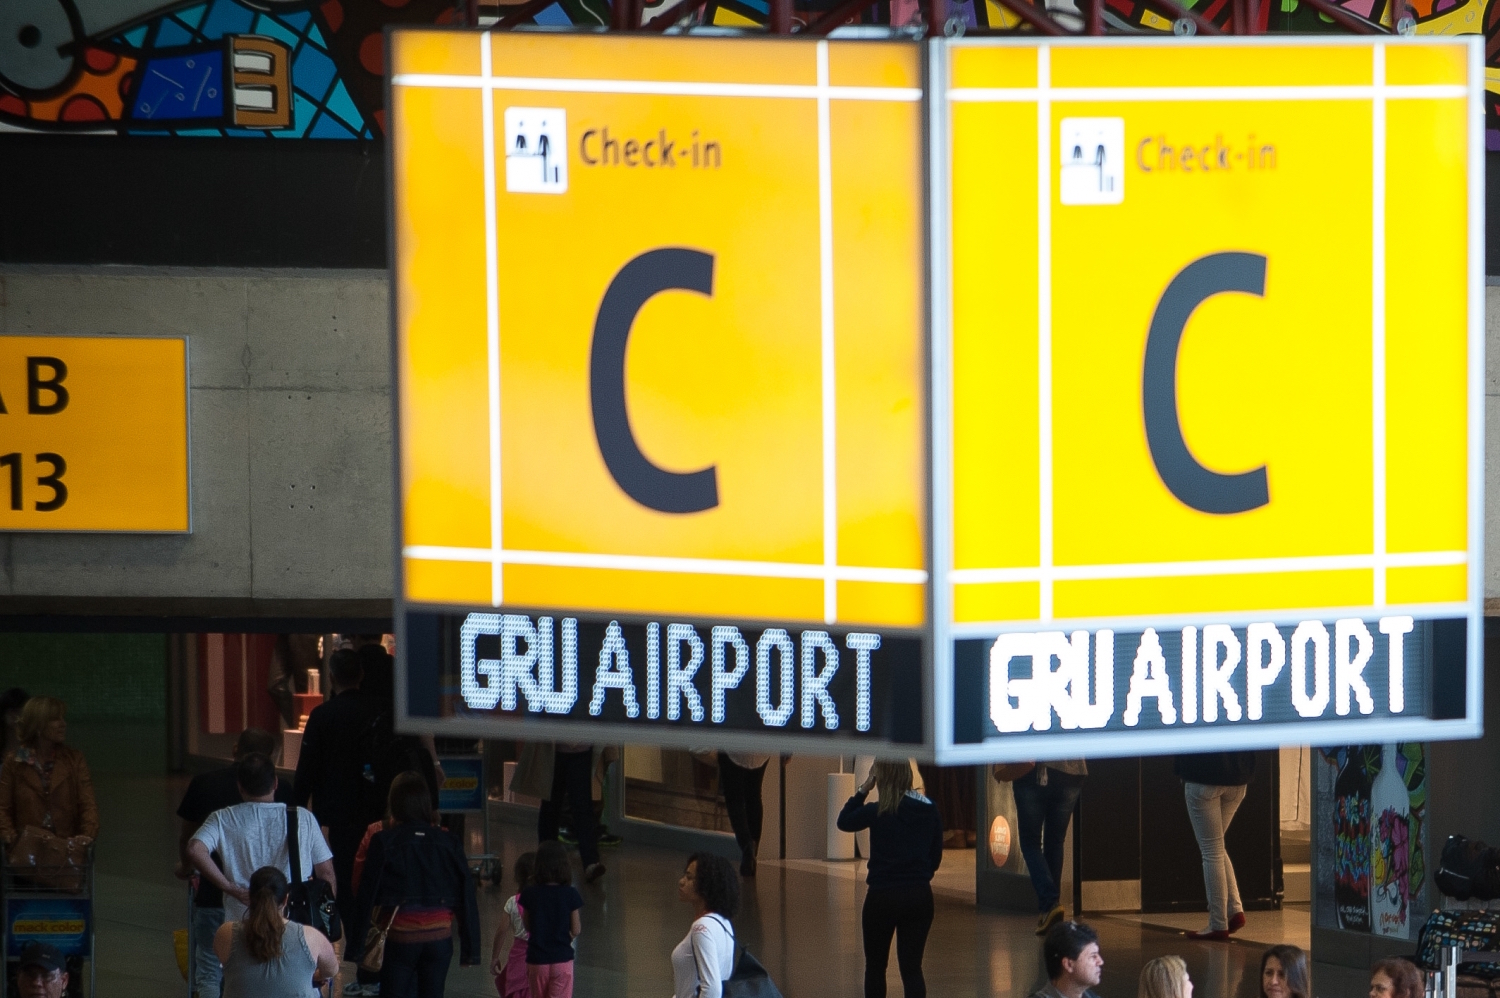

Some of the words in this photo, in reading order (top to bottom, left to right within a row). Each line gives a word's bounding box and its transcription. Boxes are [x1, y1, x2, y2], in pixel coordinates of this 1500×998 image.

[579, 126, 723, 170] Check-in
[1135, 133, 1278, 174] Check-in
[27, 356, 70, 415] B
[588, 245, 721, 515] C
[1141, 250, 1270, 515] C
[51, 922, 83, 933] color
